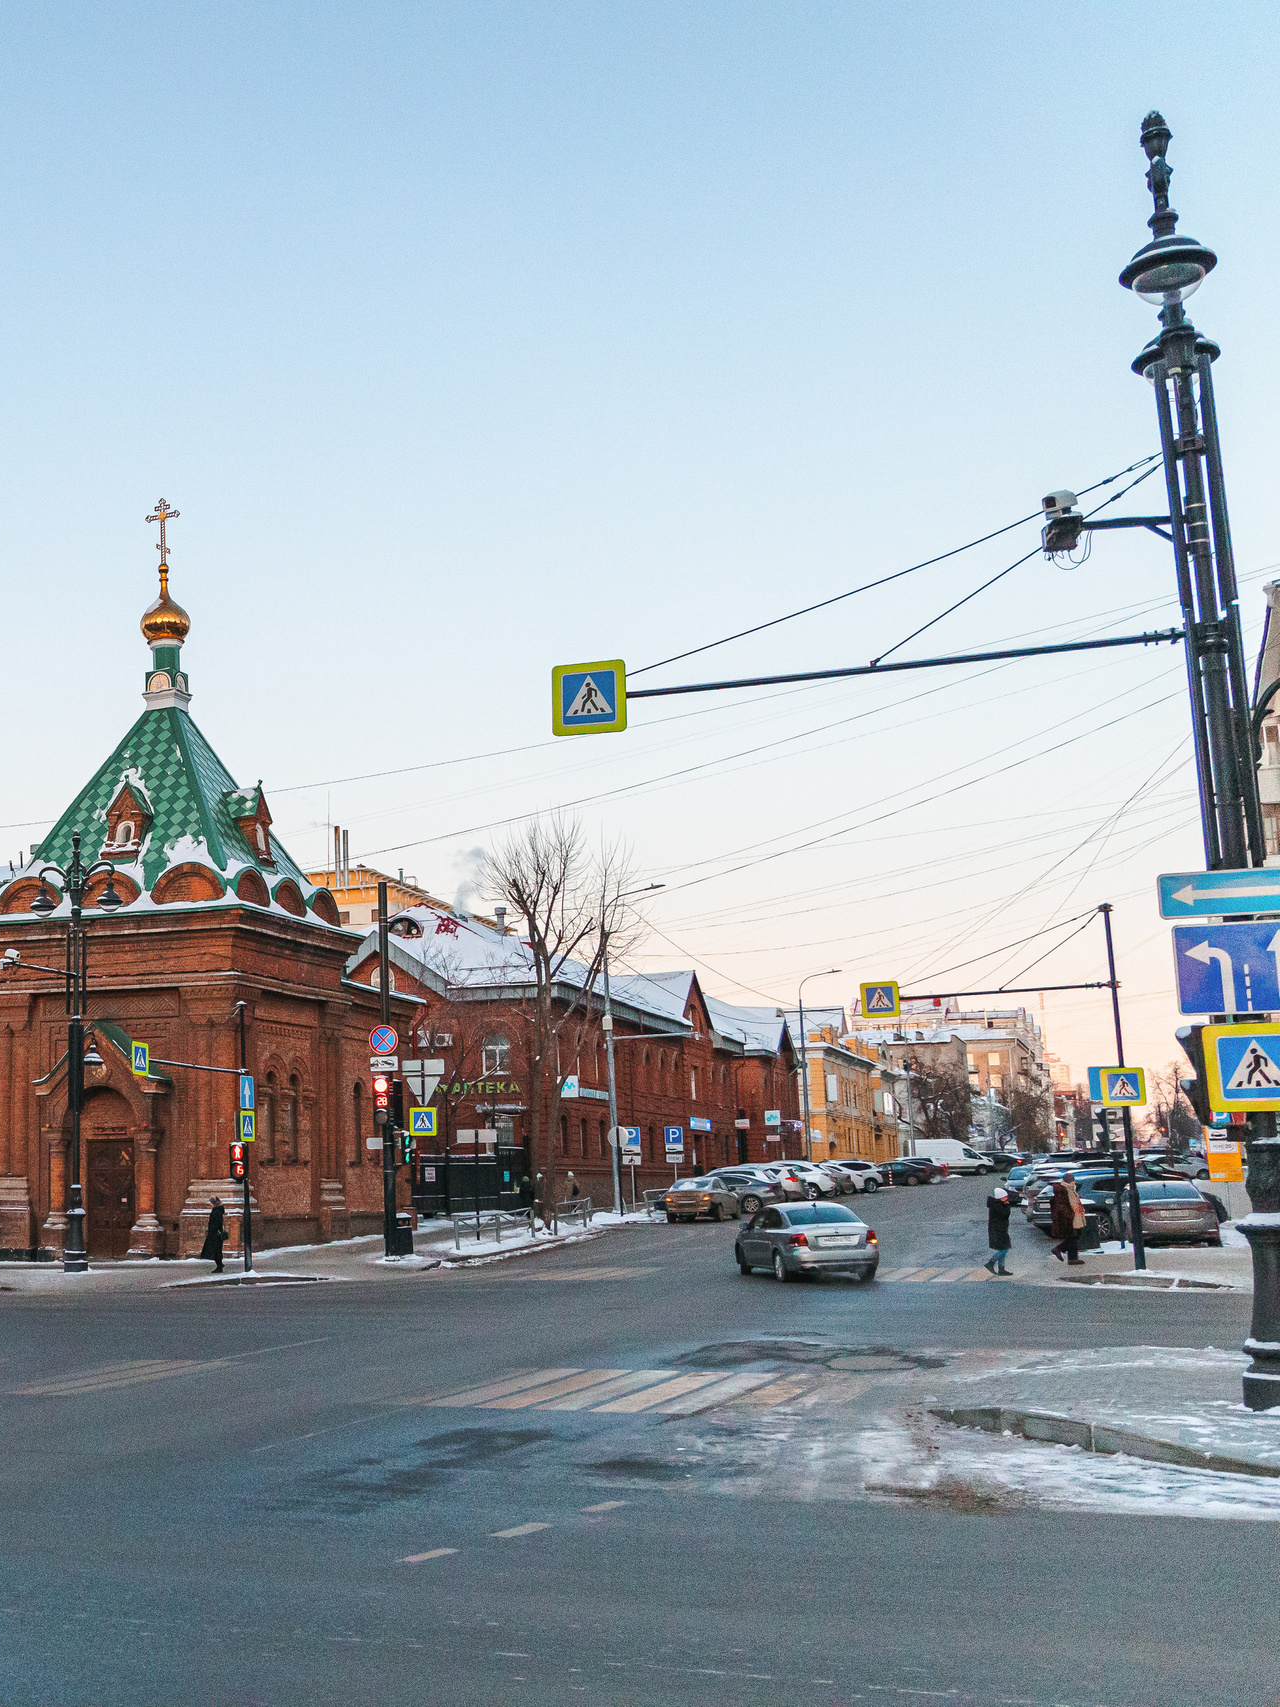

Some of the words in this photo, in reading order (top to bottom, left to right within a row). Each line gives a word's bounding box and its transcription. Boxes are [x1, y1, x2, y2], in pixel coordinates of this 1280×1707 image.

[451, 1080, 521, 1095] АПТЕКА
[376, 1097, 388, 1105] 28
[670, 1128, 679, 1142] P
